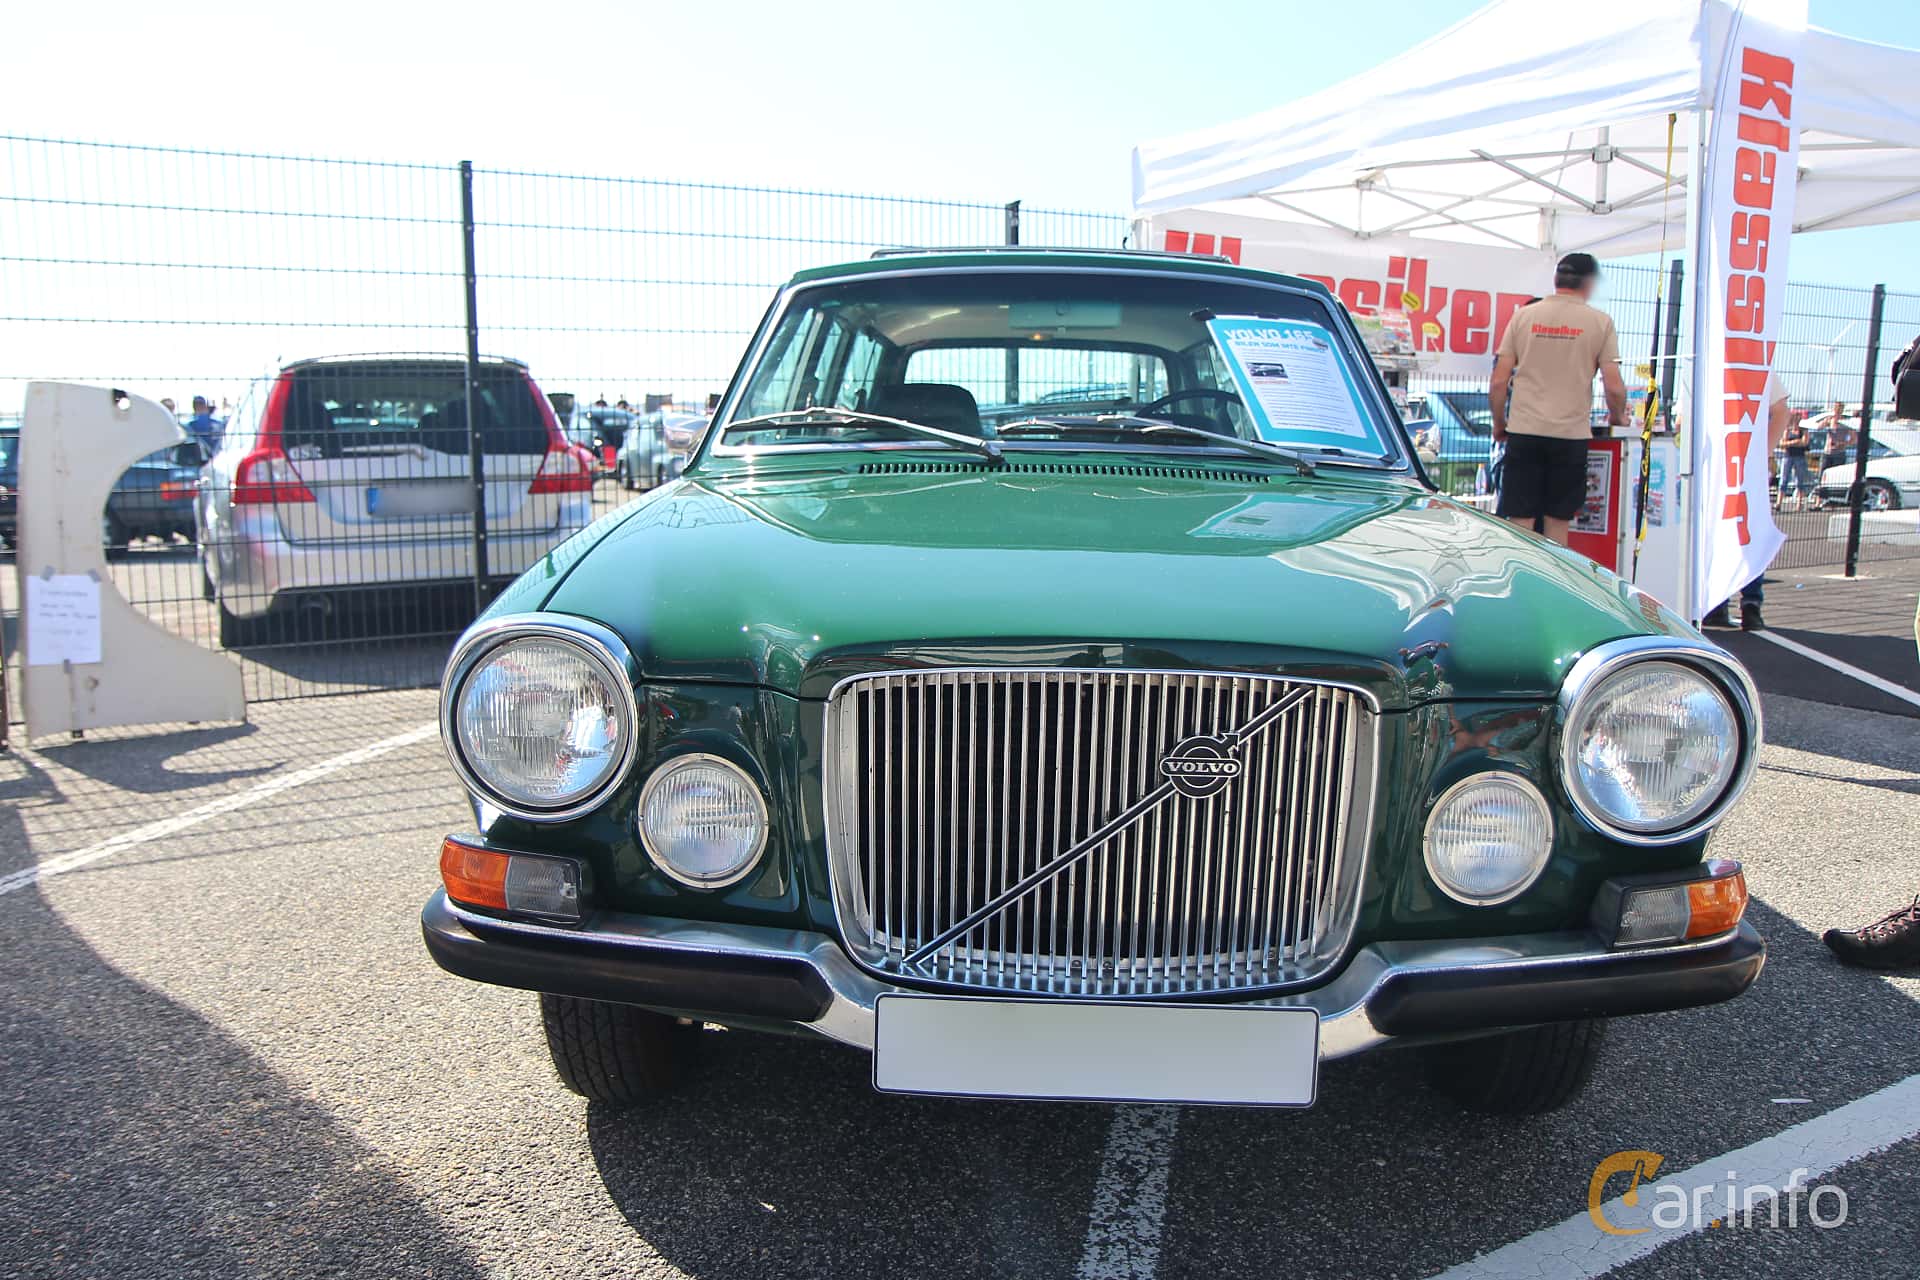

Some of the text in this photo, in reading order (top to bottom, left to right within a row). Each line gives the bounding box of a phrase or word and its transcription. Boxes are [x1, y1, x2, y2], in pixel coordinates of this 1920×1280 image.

[1721, 47, 1796, 546] Klassiker
[1223, 328, 1281, 340] VOLVO
[1165, 761, 1237, 773] VOLVO
